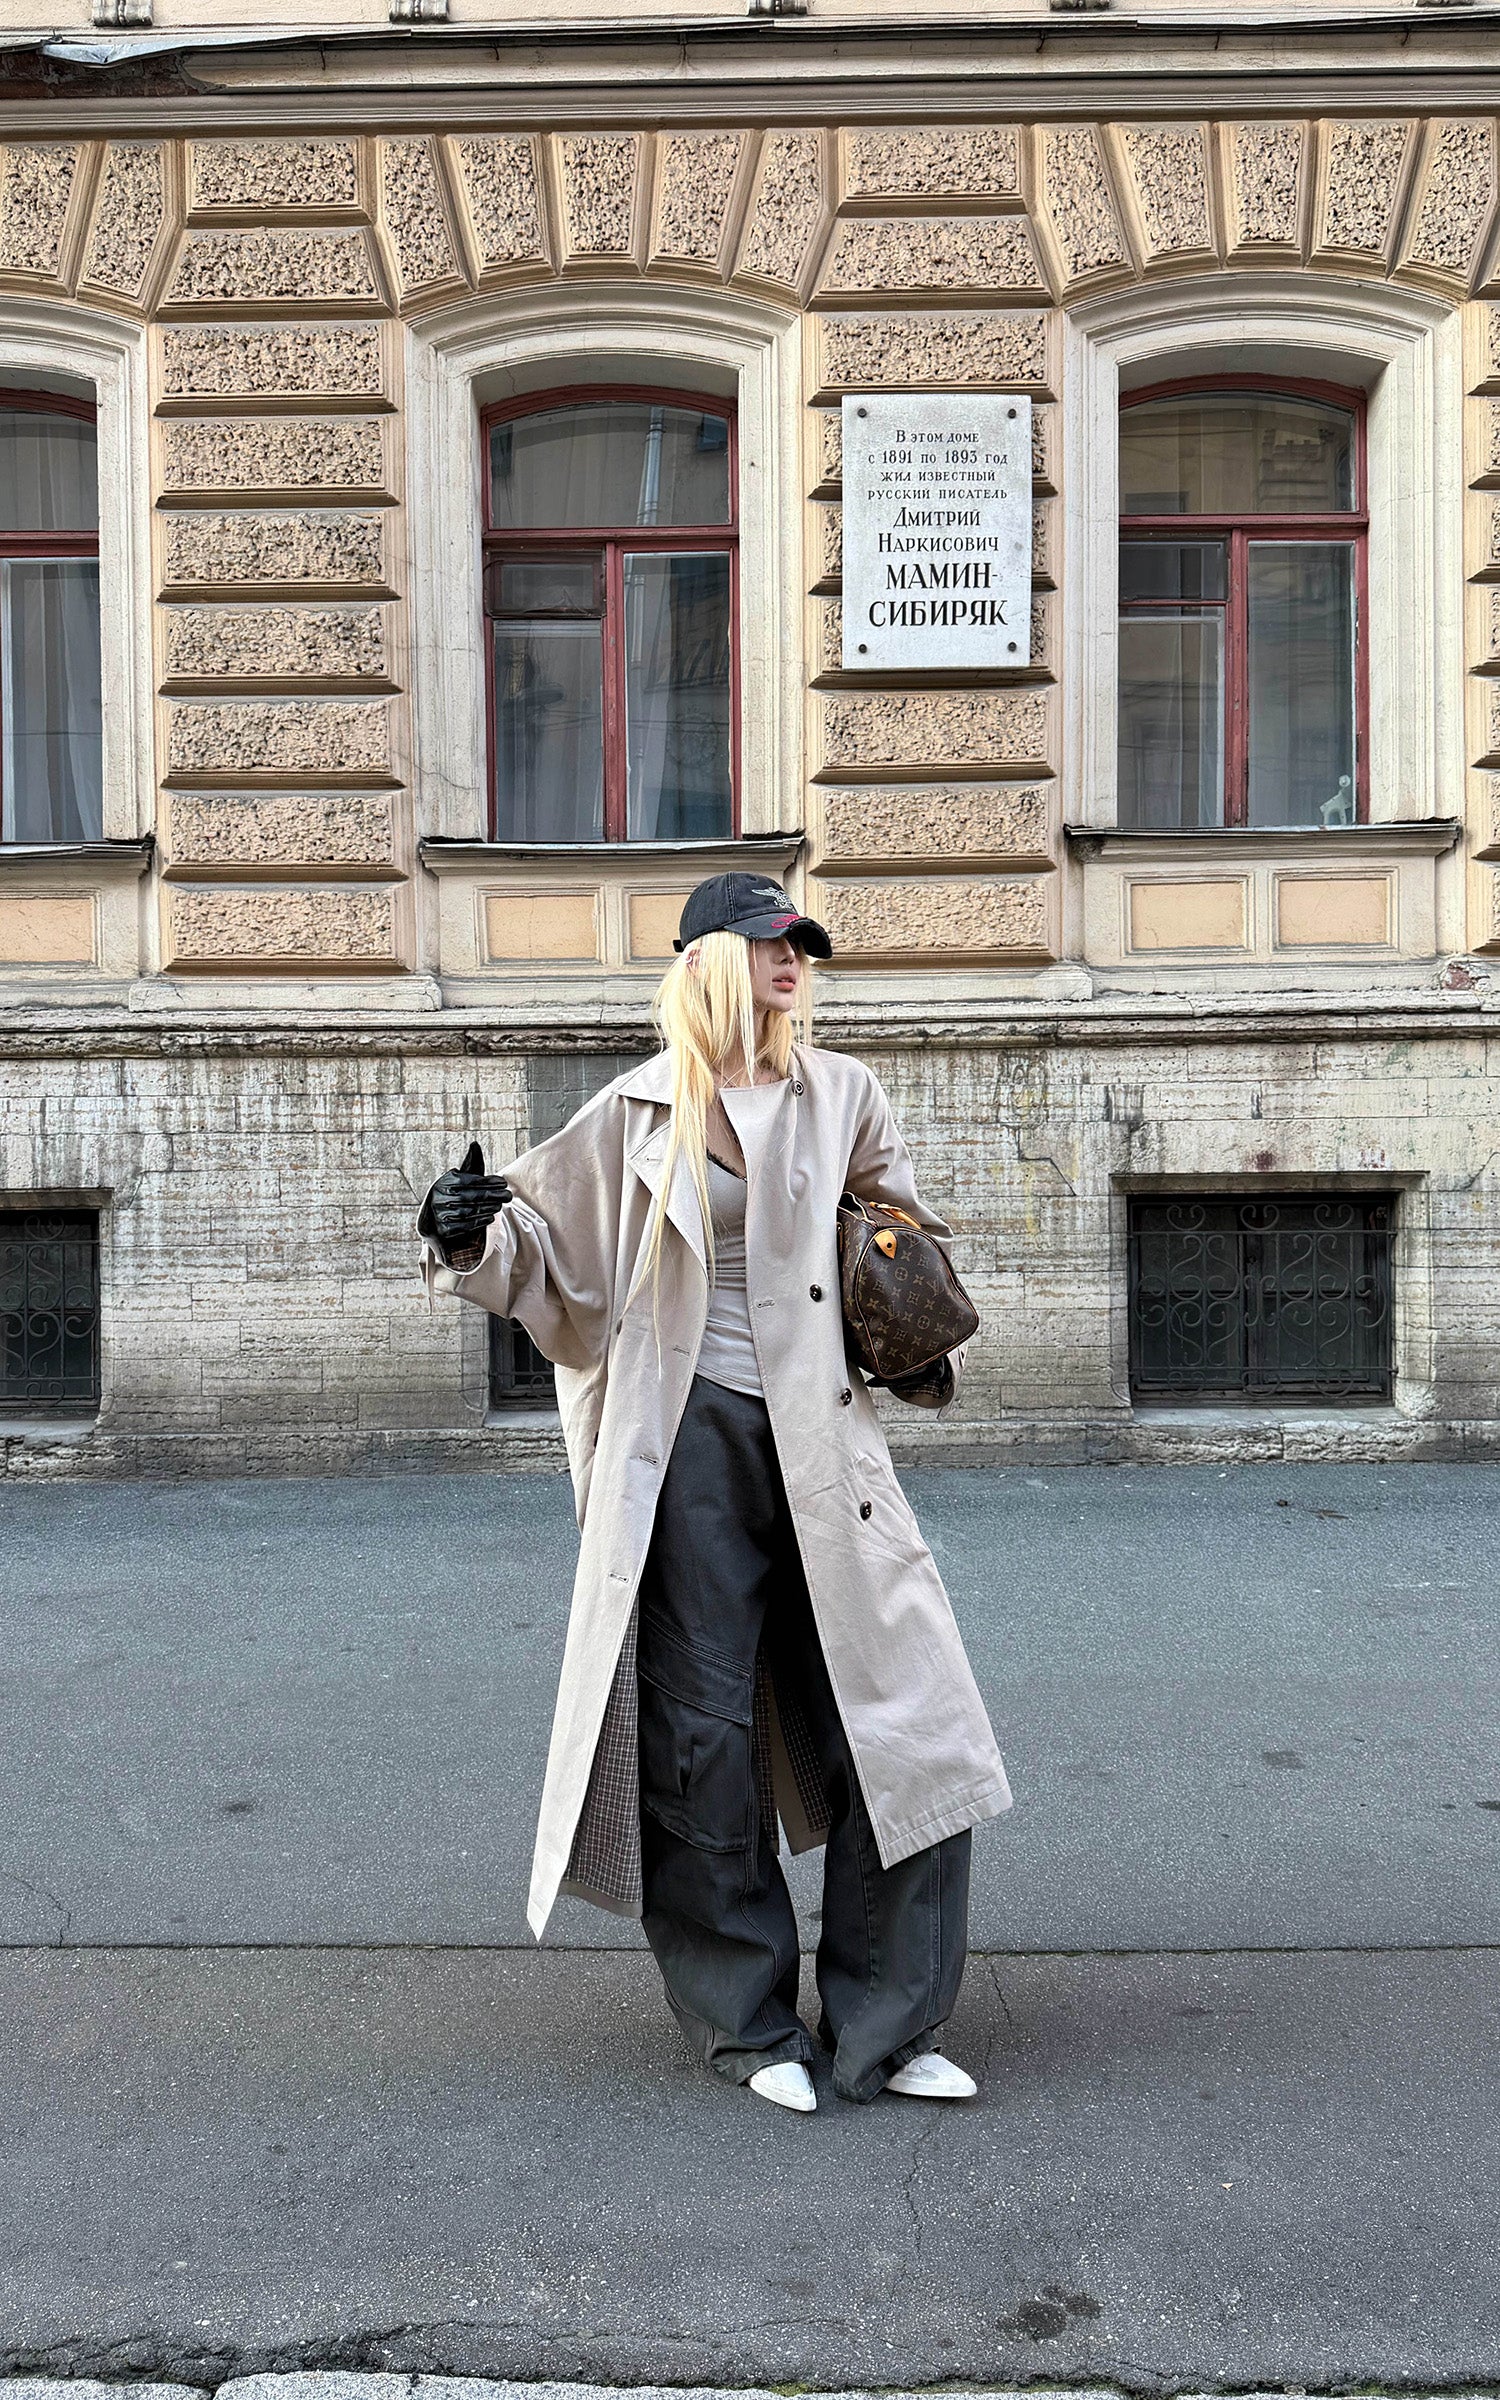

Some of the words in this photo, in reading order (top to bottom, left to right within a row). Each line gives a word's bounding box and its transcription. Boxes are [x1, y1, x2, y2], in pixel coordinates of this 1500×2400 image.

[896, 430, 906, 443] В
[883, 450, 912, 464] 1891
[945, 450, 977, 464] 1893
[886, 563, 998, 590] МАМИН-
[869, 600, 1008, 627] СИБИРЯК
